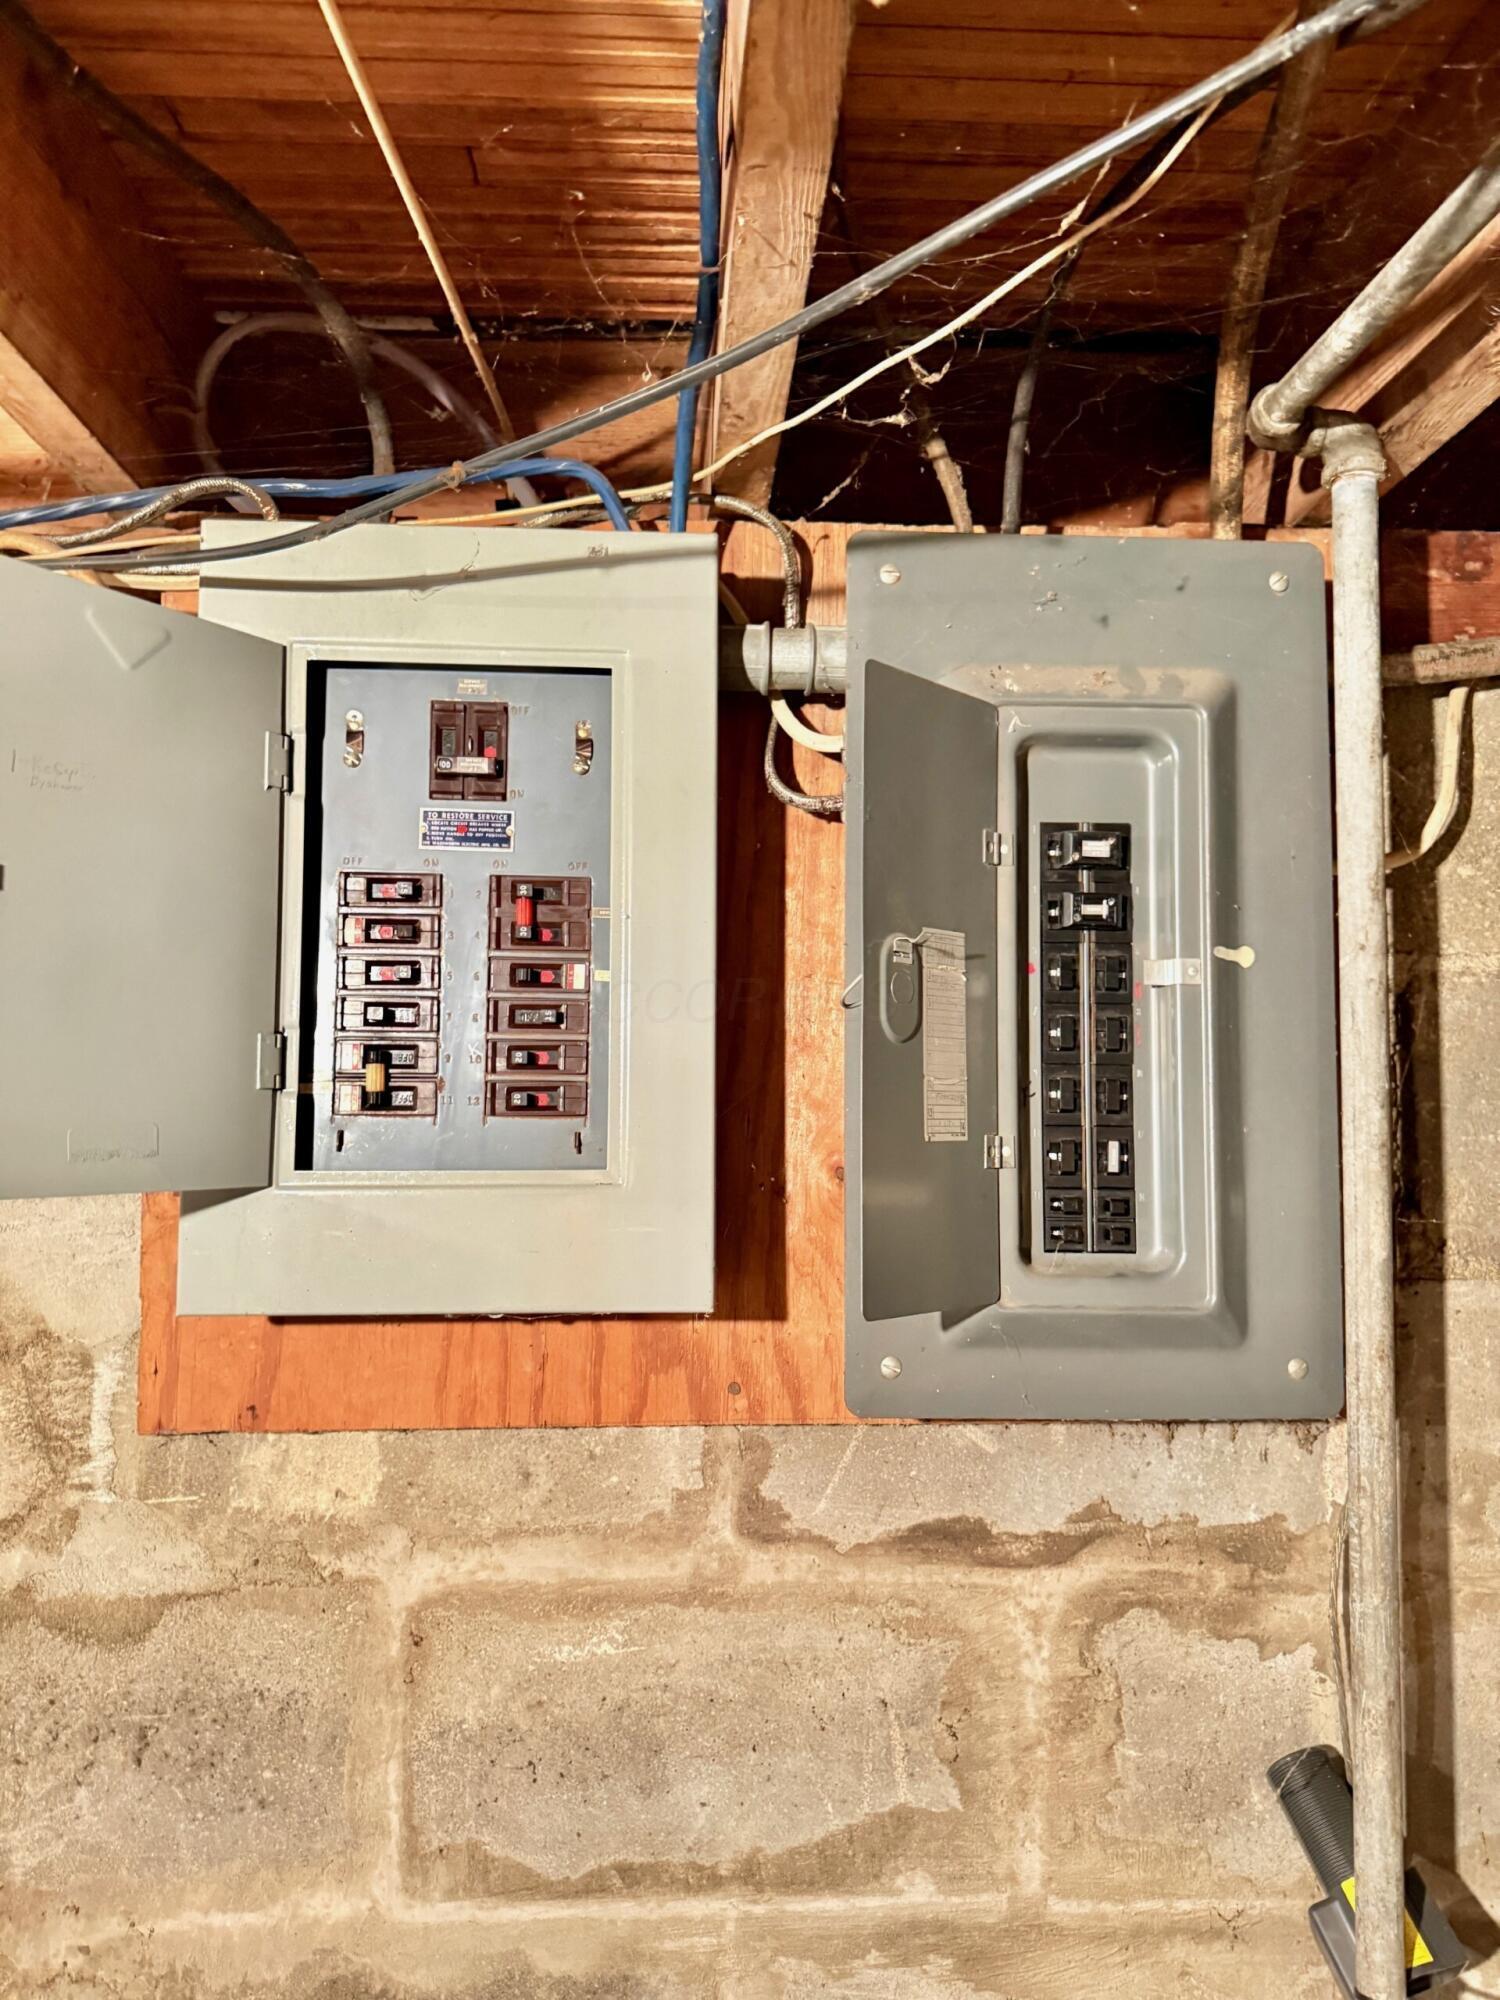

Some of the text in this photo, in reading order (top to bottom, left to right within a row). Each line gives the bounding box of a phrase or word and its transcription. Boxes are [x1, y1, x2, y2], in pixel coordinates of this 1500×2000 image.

[511, 706, 530, 715] OFF
[509, 790, 525, 799] ON
[343, 857, 363, 865] OFF
[423, 858, 439, 866] ON
[492, 860, 508, 868] ON
[568, 862, 588, 870] OFF
[520, 885, 527, 895] 30
[520, 926, 527, 937] 30
[515, 1051, 522, 1063] 20
[467, 1096, 480, 1105] 12
[513, 1093, 521, 1105] 20
